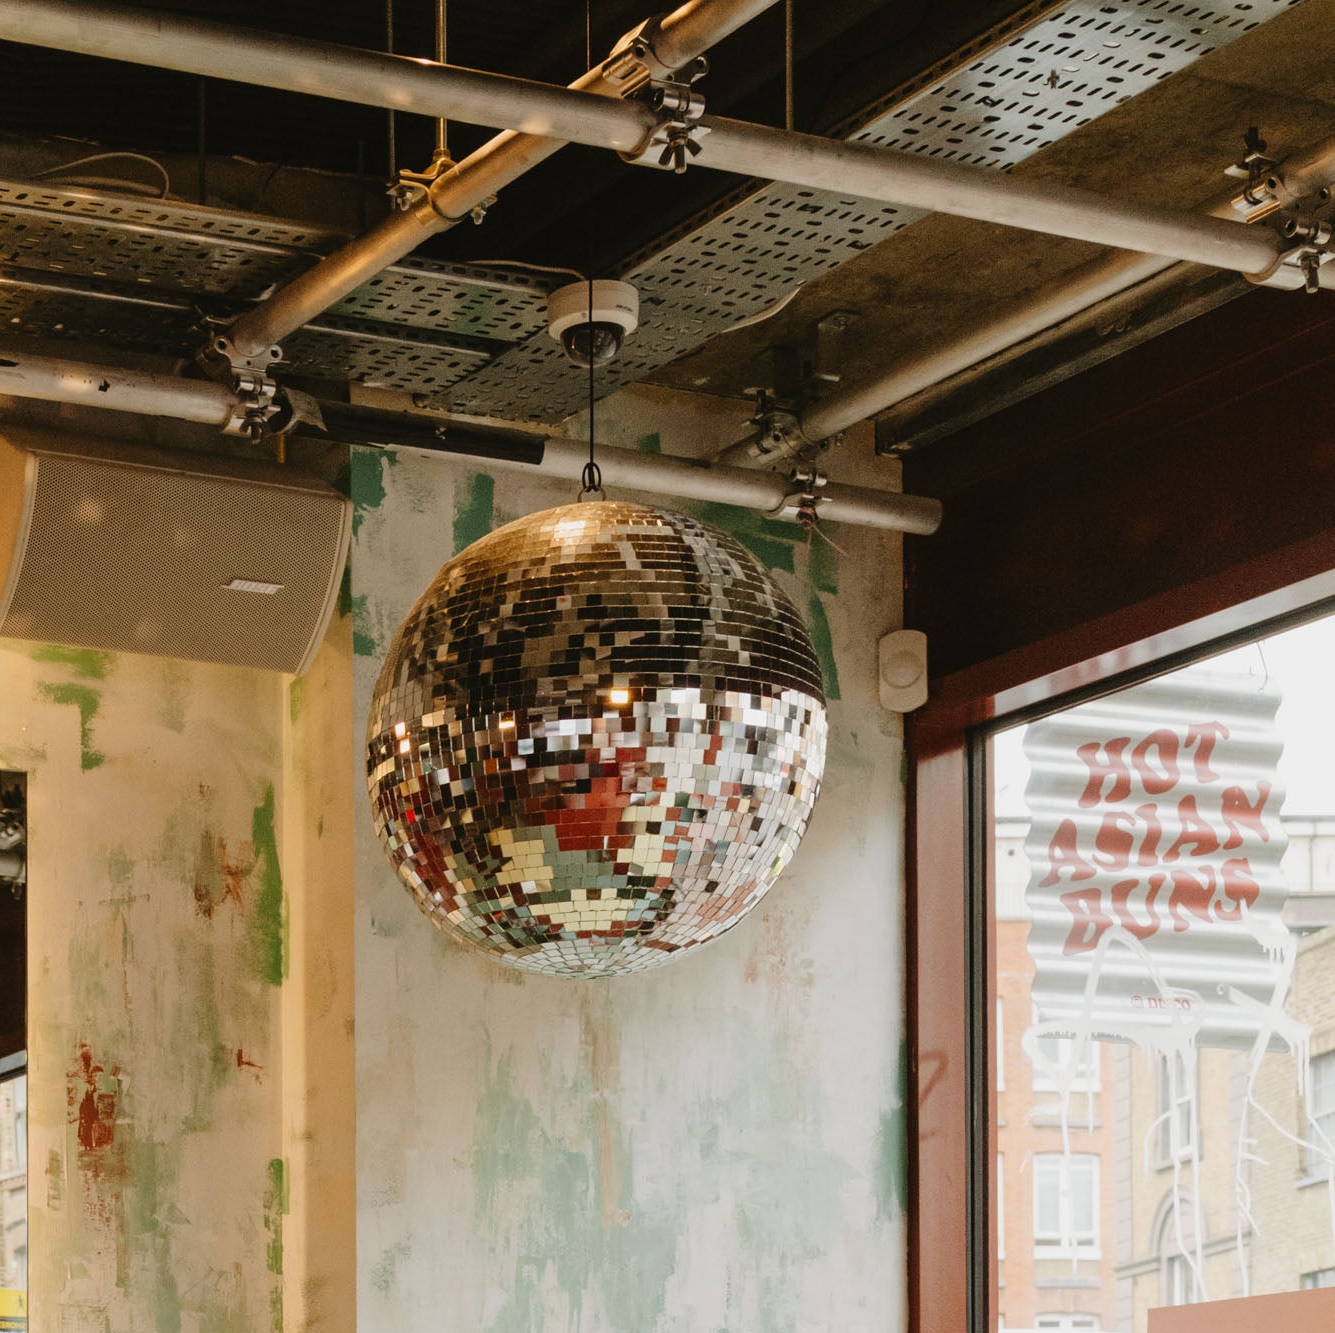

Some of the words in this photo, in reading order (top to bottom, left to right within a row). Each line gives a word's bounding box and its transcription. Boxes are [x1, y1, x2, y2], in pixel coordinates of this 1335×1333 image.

[1076, 720, 1230, 808] HOT
[1037, 781, 1272, 888] ASIAN
[1059, 857, 1260, 957] BUNS
